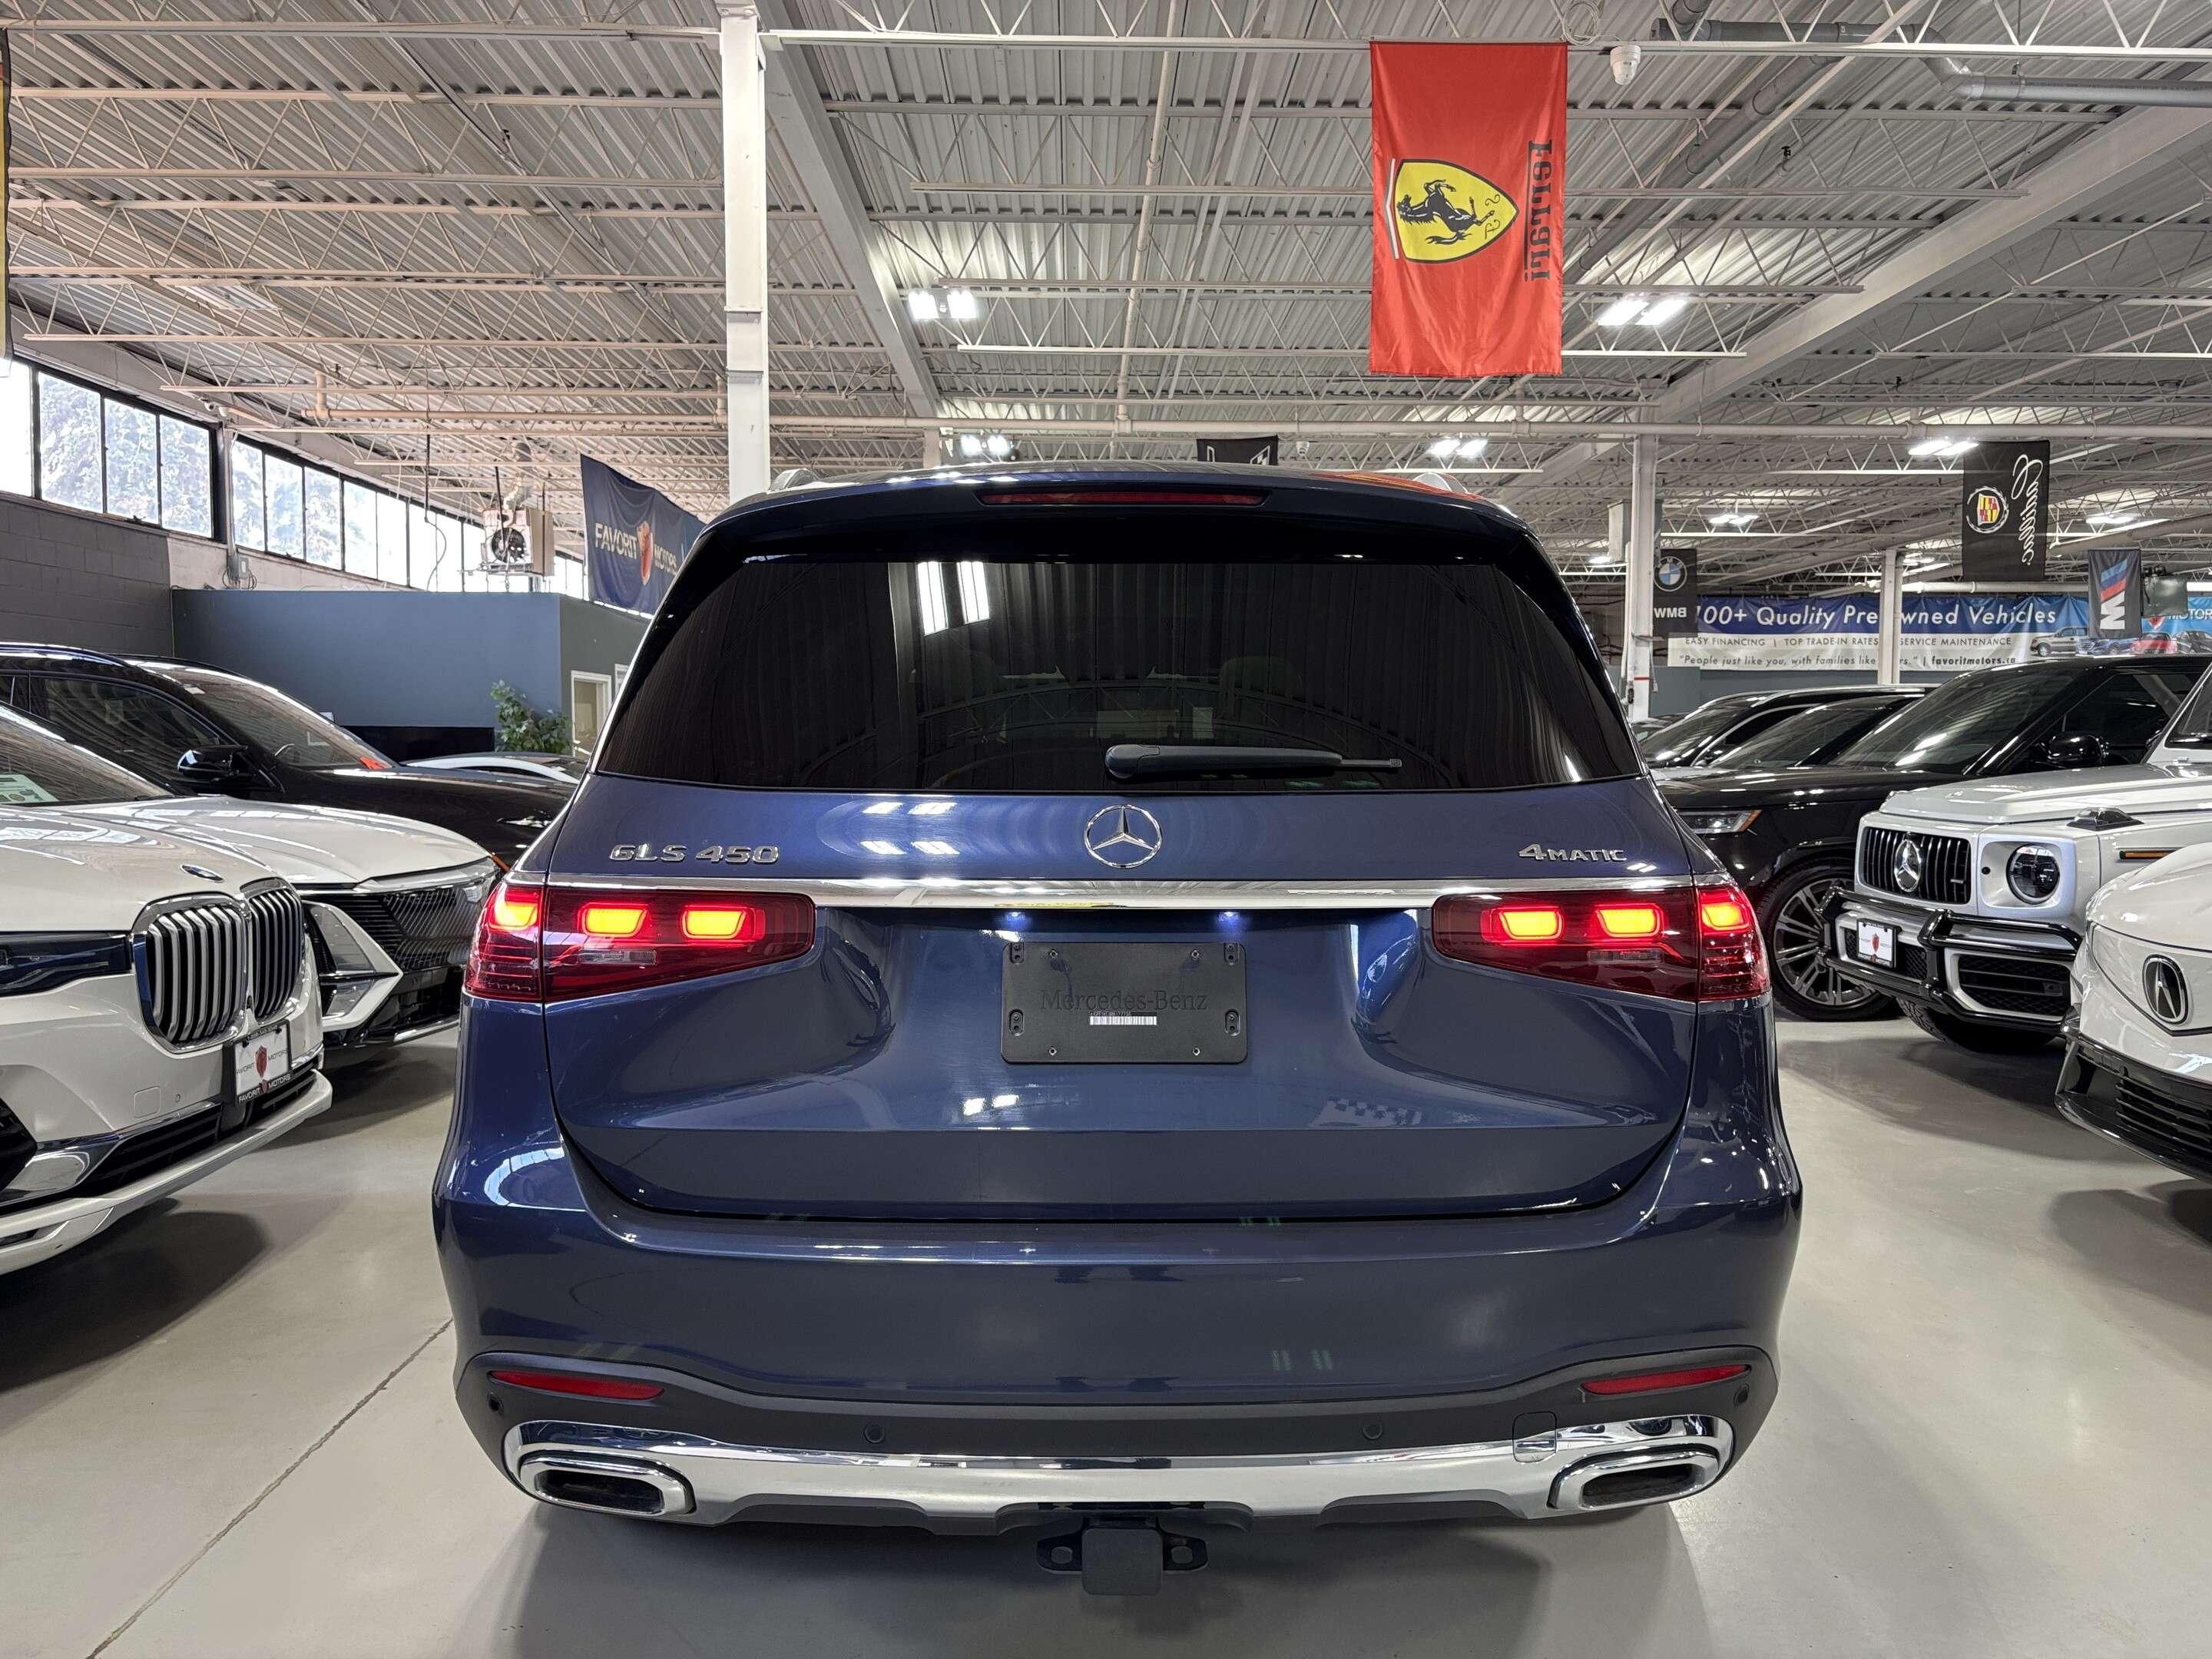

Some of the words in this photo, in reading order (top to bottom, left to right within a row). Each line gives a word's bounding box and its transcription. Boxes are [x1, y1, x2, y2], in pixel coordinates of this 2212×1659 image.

[594, 522, 637, 560] FAVORIT
[654, 544, 677, 575] MOTORS
[1757, 605, 1835, 630] Quality
[1969, 603, 2057, 625] Vehicles
[1806, 637, 1847, 646] TRADE-IN
[1899, 637, 1936, 646] SERVICE
[1941, 637, 2012, 646] MAINTENANCE
[1722, 655, 1741, 665] just
[1744, 655, 1763, 665] like
[1767, 657, 1786, 666] you,
[1791, 655, 1811, 664] with
[1816, 655, 1855, 665] families
[1859, 655, 1876, 664] like
[1932, 656, 2015, 665] favoritmotors.ca
[609, 843, 687, 862] GLS
[695, 845, 780, 863] 450
[1518, 843, 1627, 861] 4MATIC
[1039, 989, 1208, 1011] Mercedes-Benz
[238, 1088, 261, 1104] FAVORIT
[268, 1074, 291, 1089] MOTORS
